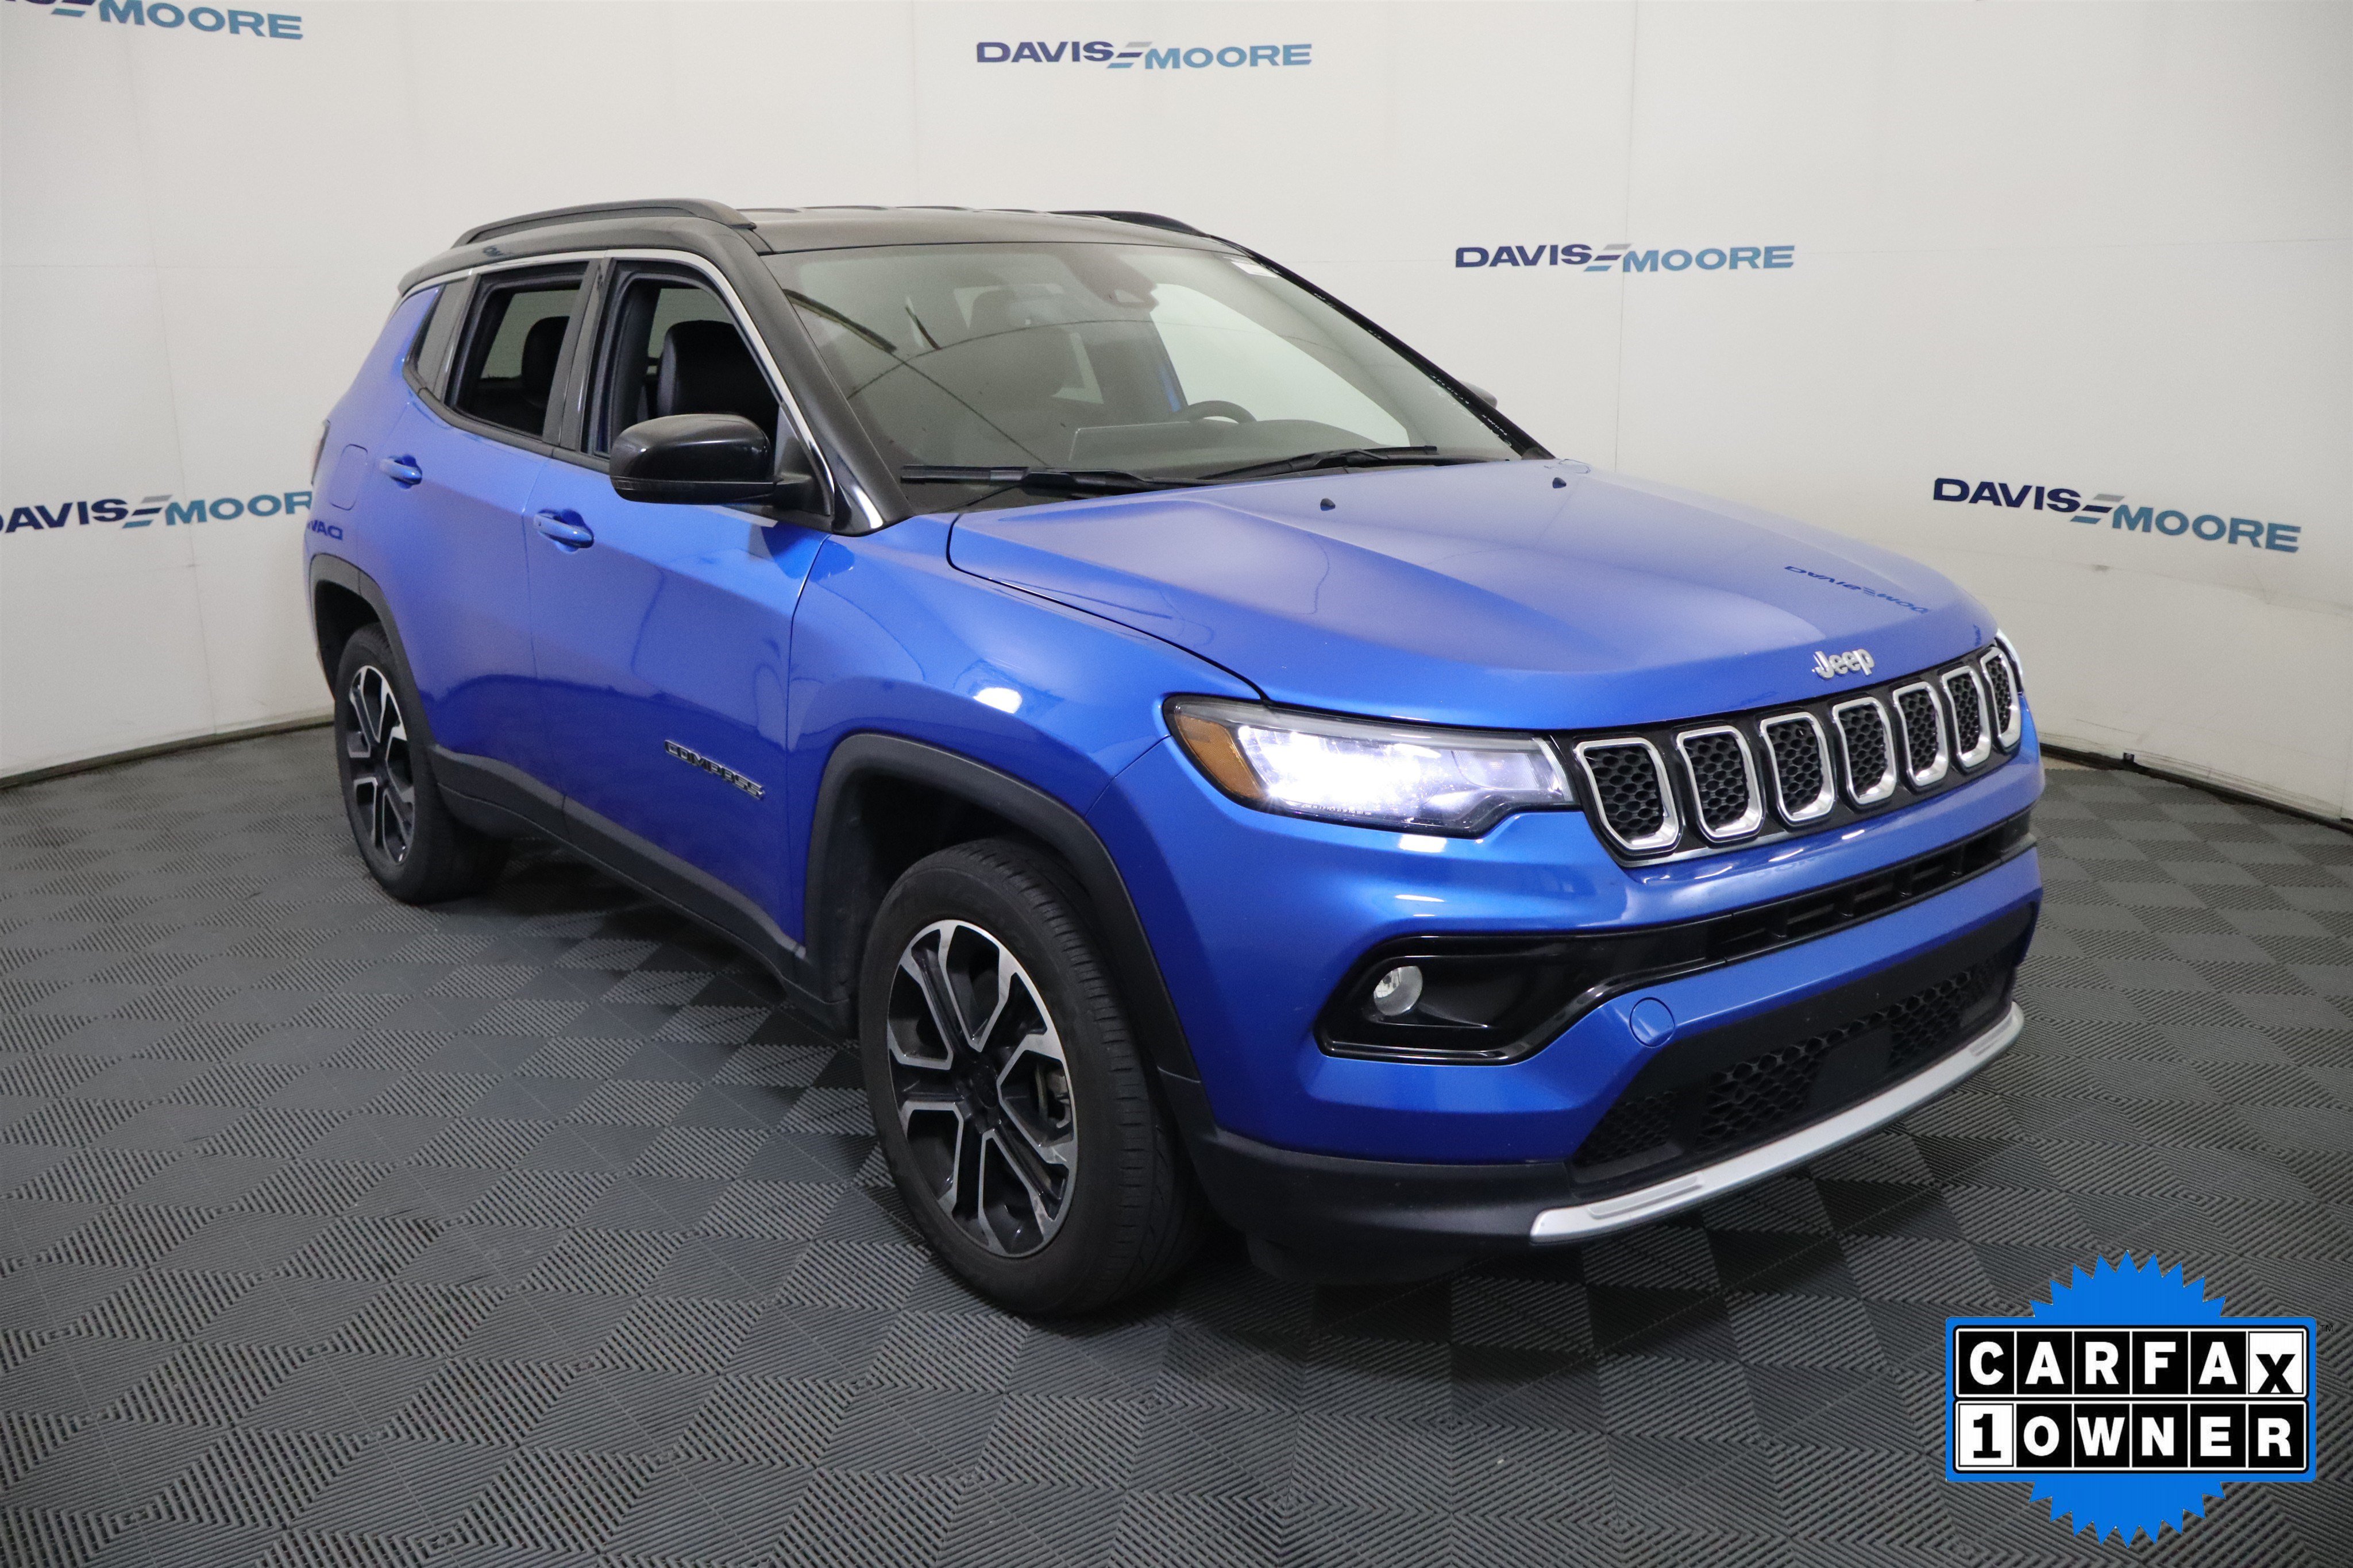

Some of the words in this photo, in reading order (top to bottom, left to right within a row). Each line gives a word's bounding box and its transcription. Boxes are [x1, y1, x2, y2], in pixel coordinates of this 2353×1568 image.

[98, 0, 303, 40] MOORE
[976, 41, 1114, 63] DAVIS
[1145, 43, 1312, 69] MOORE
[1455, 244, 1592, 268] DAVIS
[1622, 245, 1795, 273] MOORE
[0, 498, 129, 534] AVIS
[164, 491, 313, 526] MOOR
[1932, 477, 2081, 513] DAVIS
[2111, 504, 2301, 554] MOORE
[1811, 648, 1875, 681] Jeep
